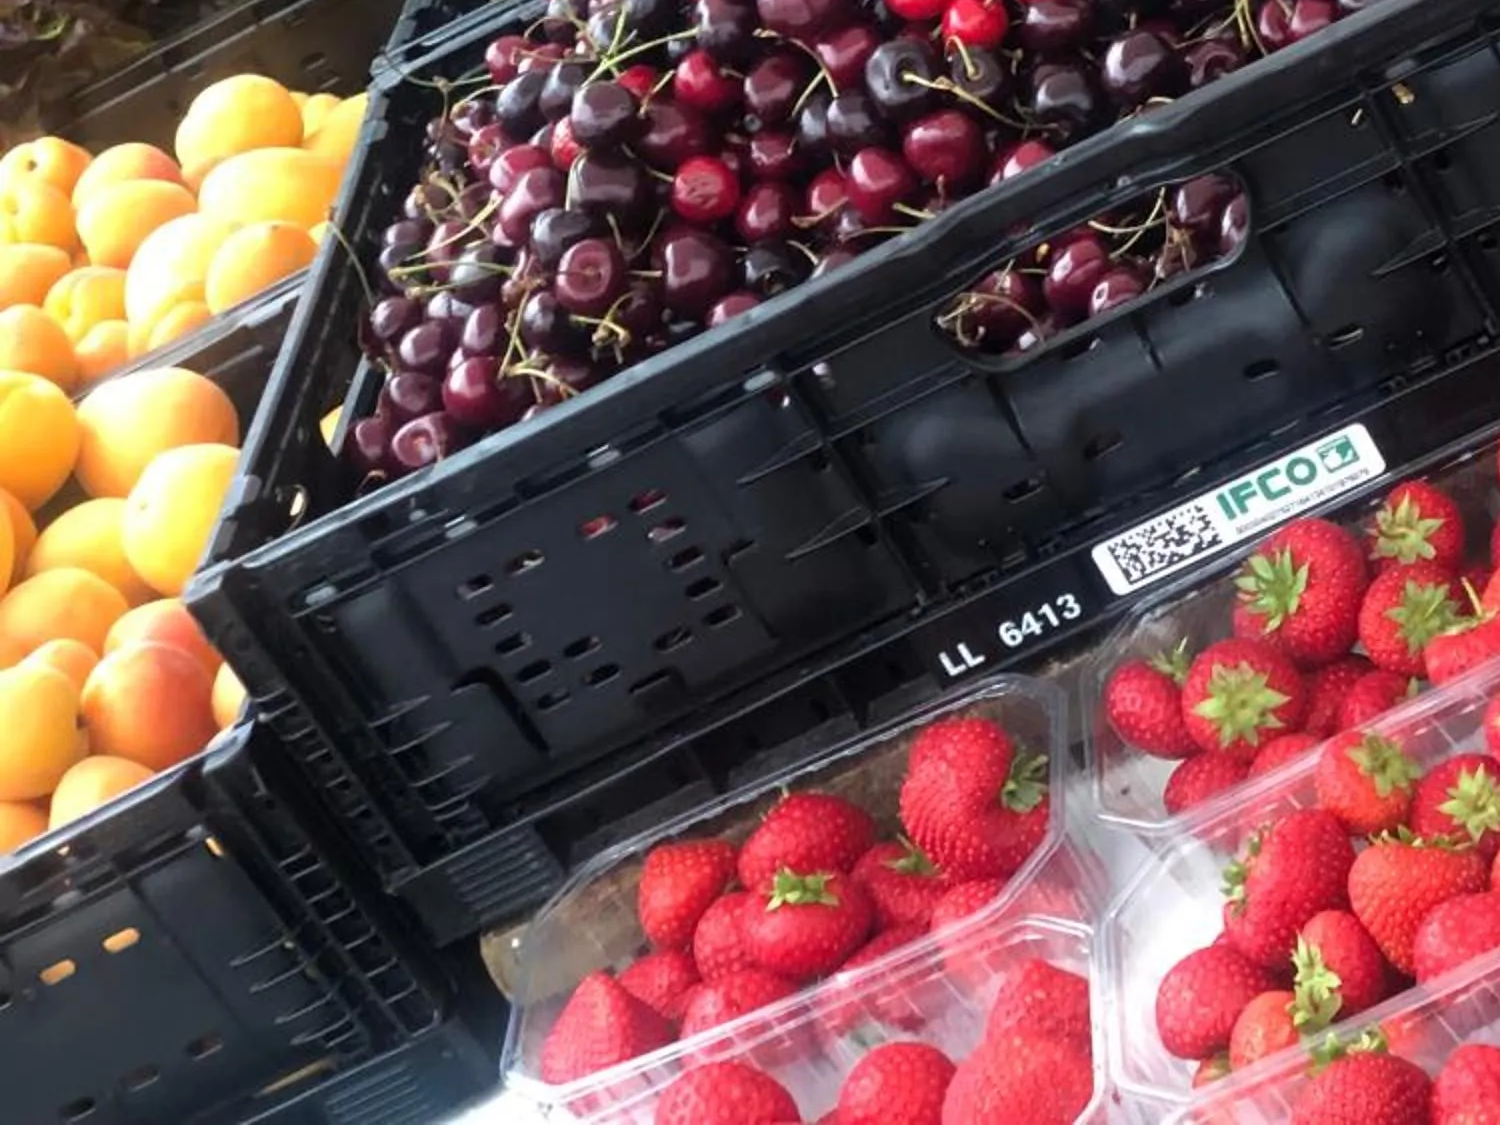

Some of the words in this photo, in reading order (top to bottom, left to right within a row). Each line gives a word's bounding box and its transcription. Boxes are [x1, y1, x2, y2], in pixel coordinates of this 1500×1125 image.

[1216, 456, 1317, 520] IFCO
[939, 643, 985, 676] LL
[999, 593, 1081, 647] 6413
